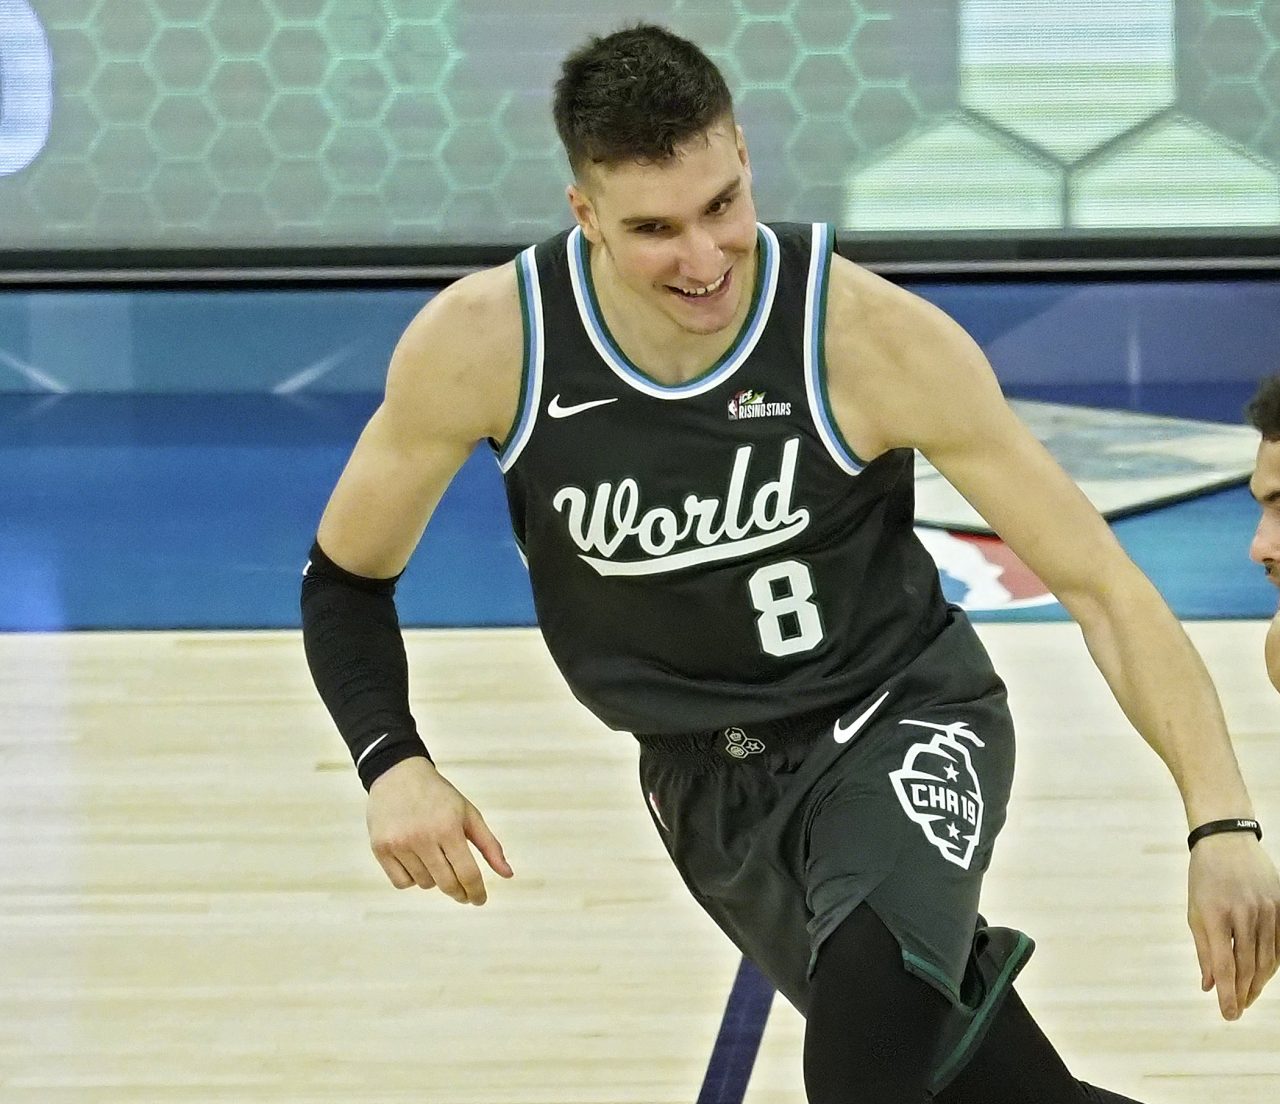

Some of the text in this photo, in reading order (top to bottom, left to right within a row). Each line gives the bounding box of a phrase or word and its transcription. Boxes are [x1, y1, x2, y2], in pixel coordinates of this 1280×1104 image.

[738, 403, 766, 420] RISING
[766, 402, 792, 417] STARS
[552, 437, 811, 577] World
[748, 559, 824, 658] 8
